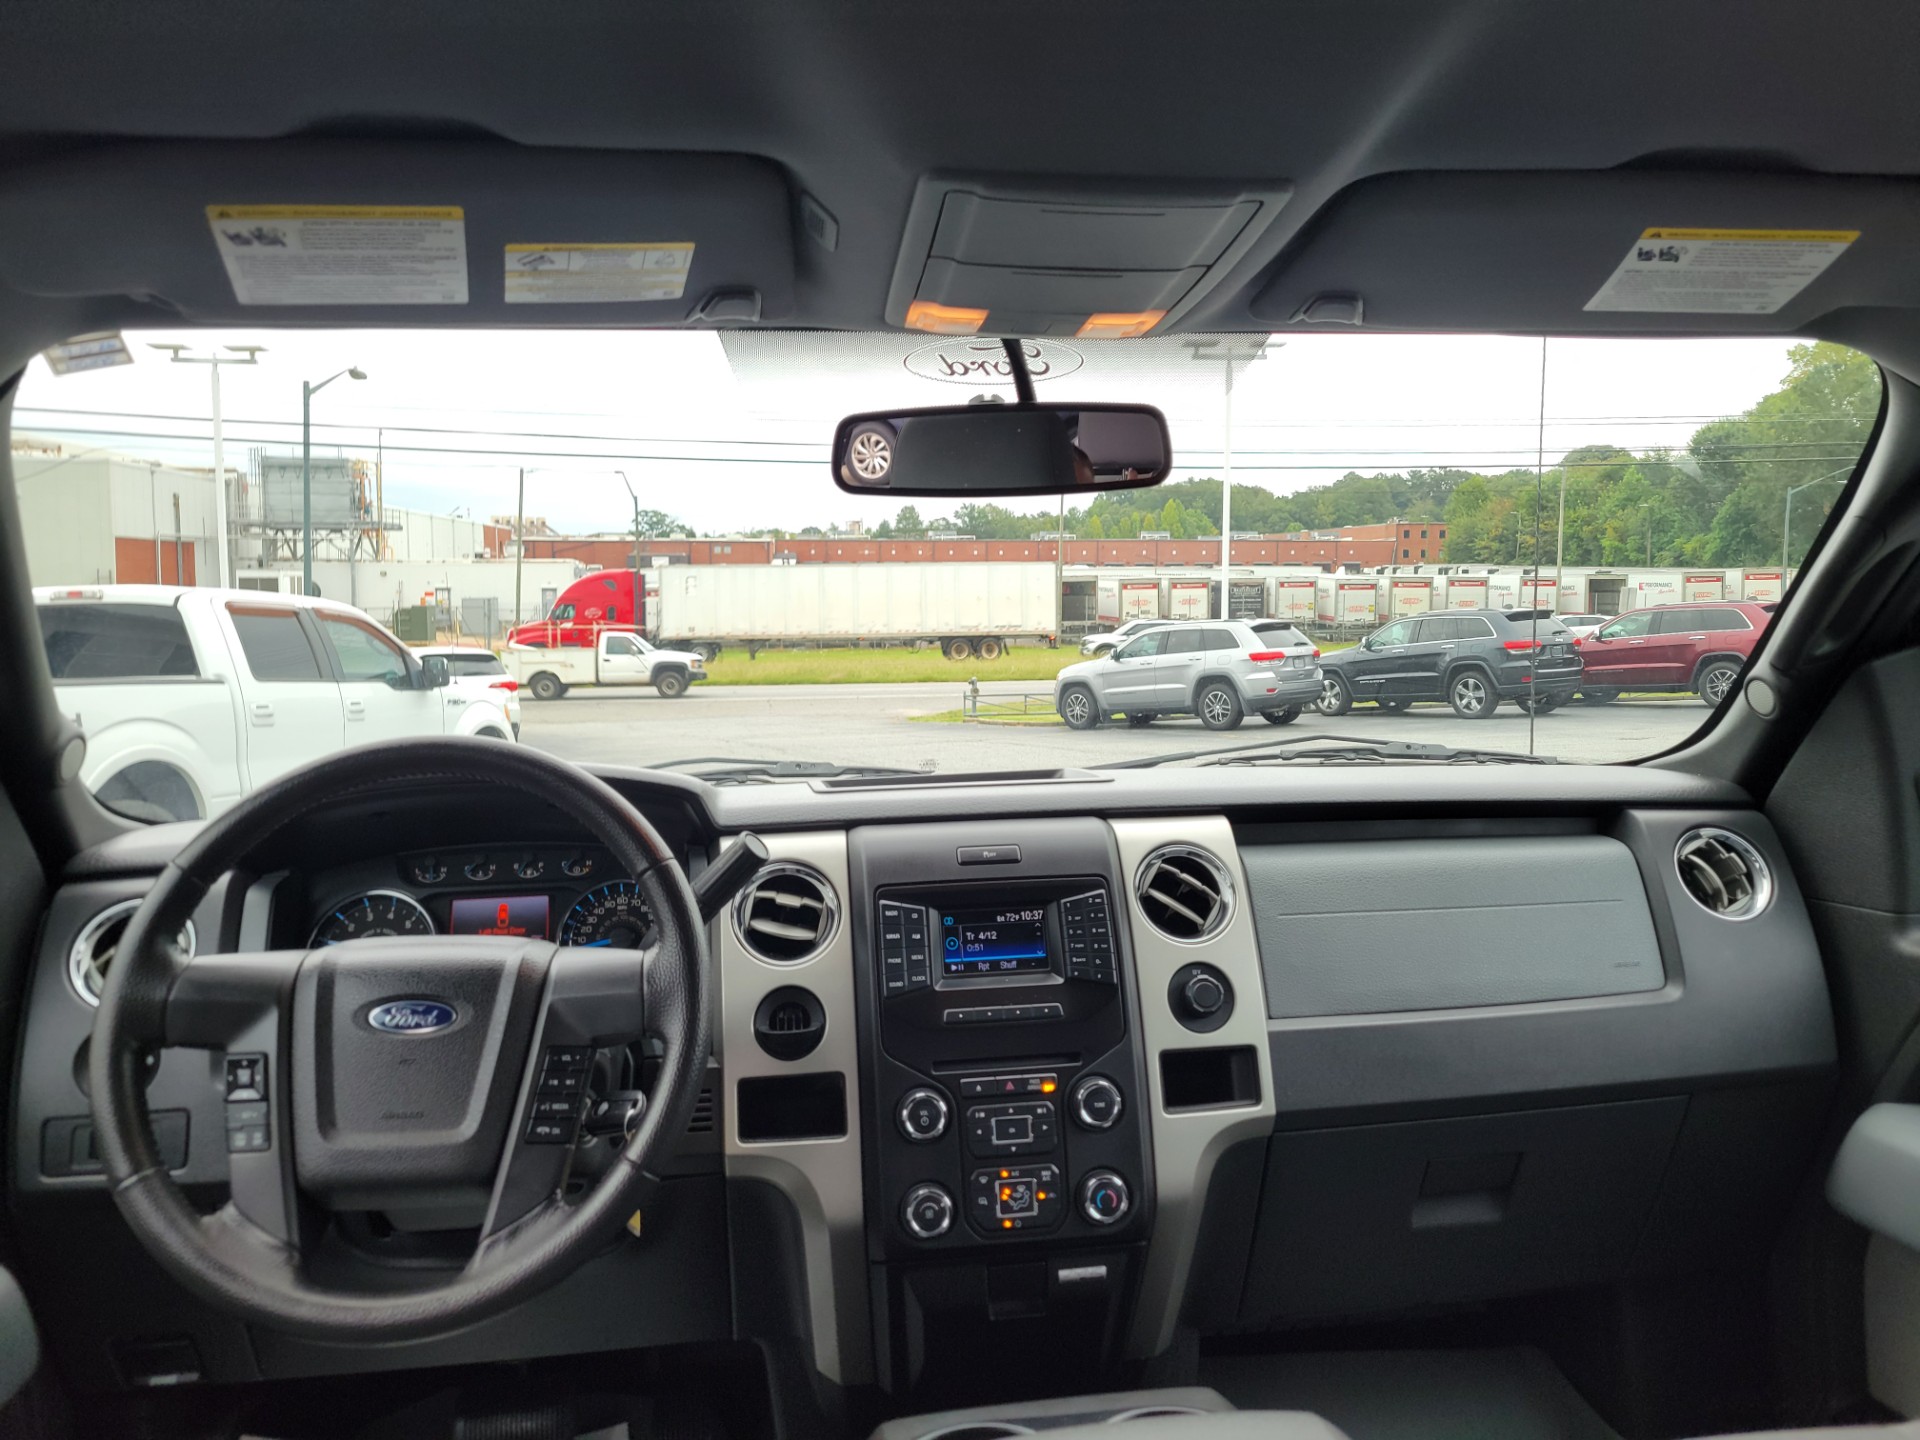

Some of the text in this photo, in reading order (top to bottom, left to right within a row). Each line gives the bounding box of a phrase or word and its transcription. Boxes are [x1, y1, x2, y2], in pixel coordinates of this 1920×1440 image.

[616, 896, 629, 905] 60
[630, 899, 641, 907] 70
[592, 907, 605, 915] 40
[1020, 909, 1044, 921] 10:37
[586, 916, 598, 924] 30
[580, 926, 593, 934] 20
[966, 931, 998, 940] Tr 4/12
[577, 936, 587, 944] 10
[966, 944, 984, 952] 0:51
[384, 1004, 439, 1028] Ford
